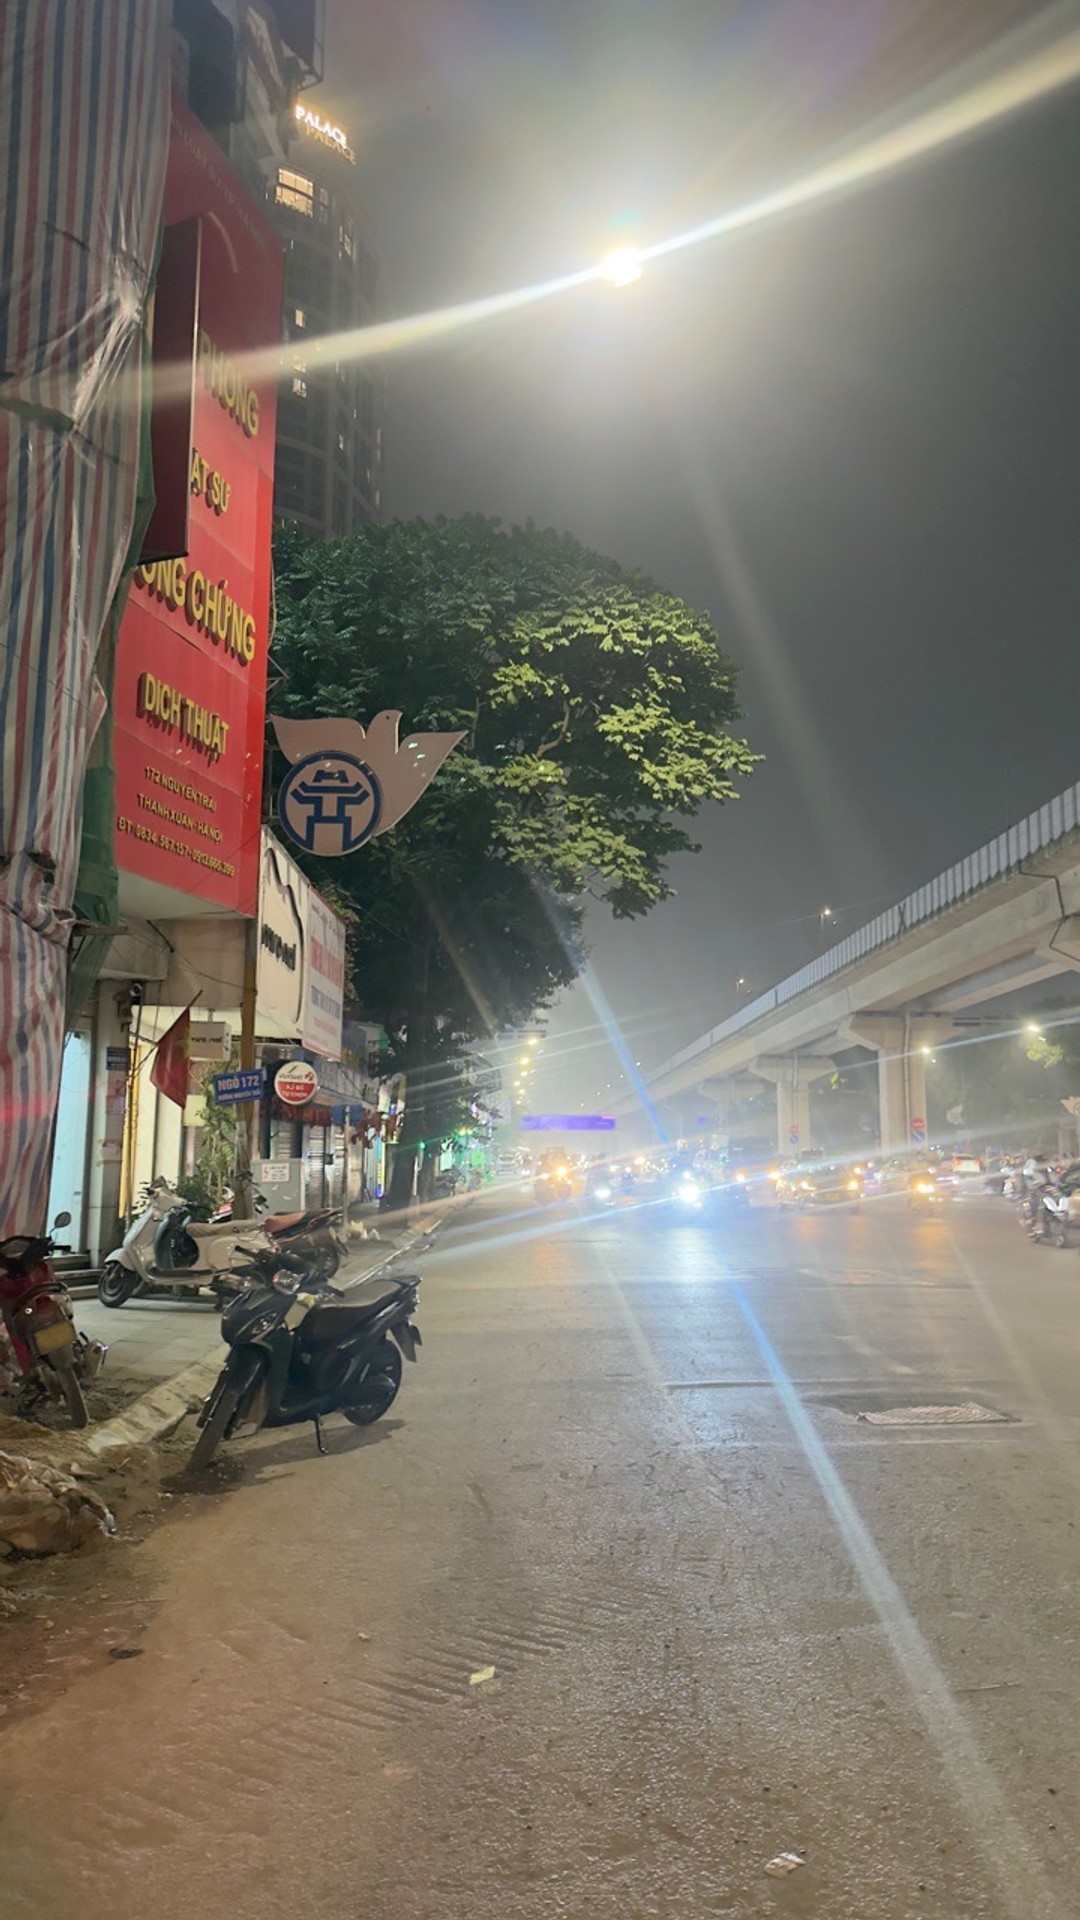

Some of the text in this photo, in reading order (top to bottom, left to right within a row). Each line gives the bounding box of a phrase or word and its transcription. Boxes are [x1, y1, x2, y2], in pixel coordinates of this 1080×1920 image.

[190, 569, 257, 662] CHỨNG
[185, 698, 230, 760] THUẬT
[145, 765, 161, 784] 172
[138, 792, 170, 820] THANH
[241, 1074, 260, 1089] 172
